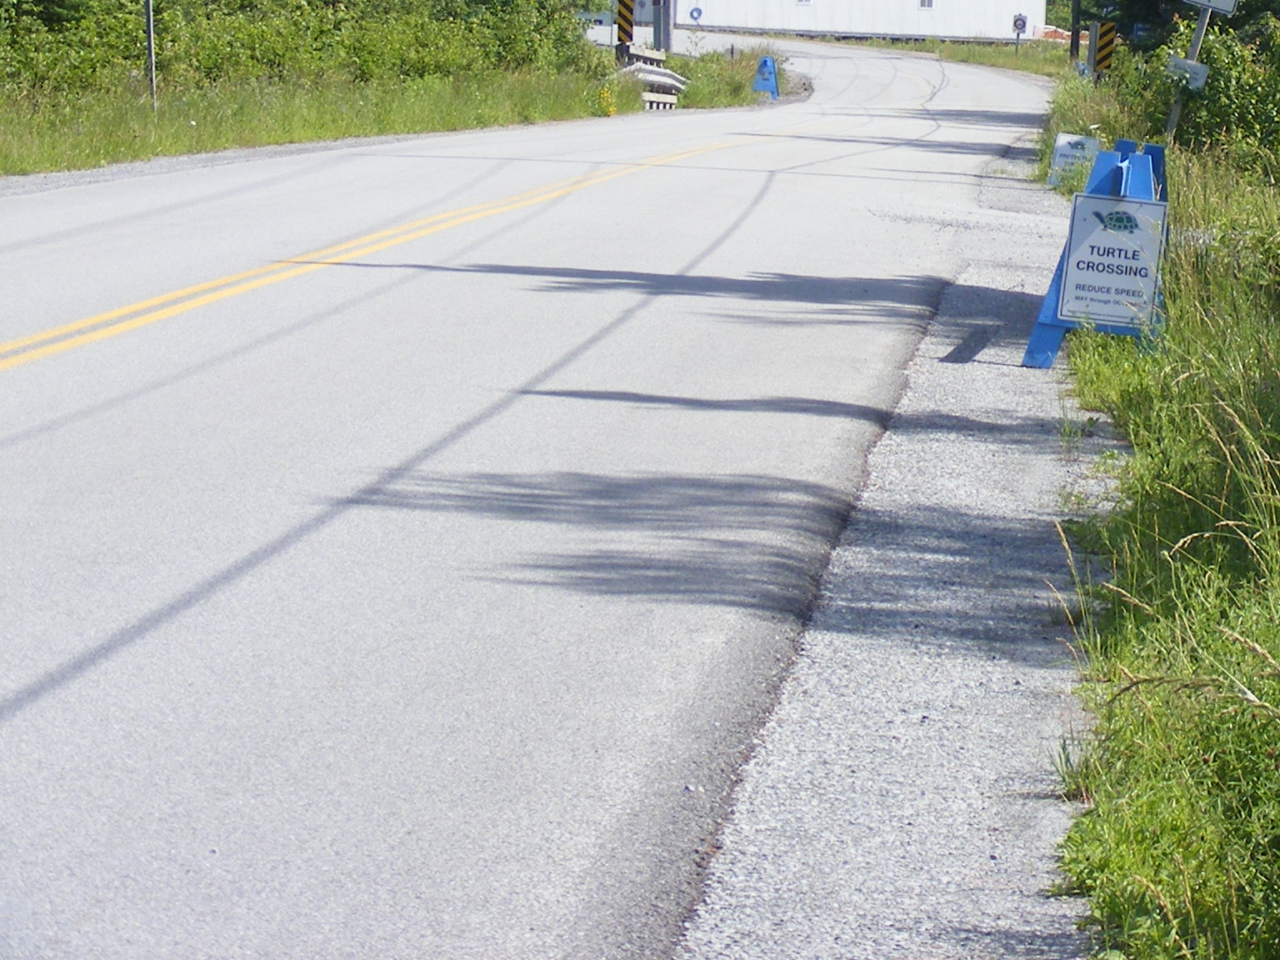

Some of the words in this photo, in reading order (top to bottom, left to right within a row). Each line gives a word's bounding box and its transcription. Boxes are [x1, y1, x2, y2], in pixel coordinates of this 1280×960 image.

[1088, 245, 1140, 261] TURTLE
[1076, 260, 1149, 278] CROSSING
[1075, 283, 1112, 295] REDUCE
[1114, 287, 1145, 298] SPEED
